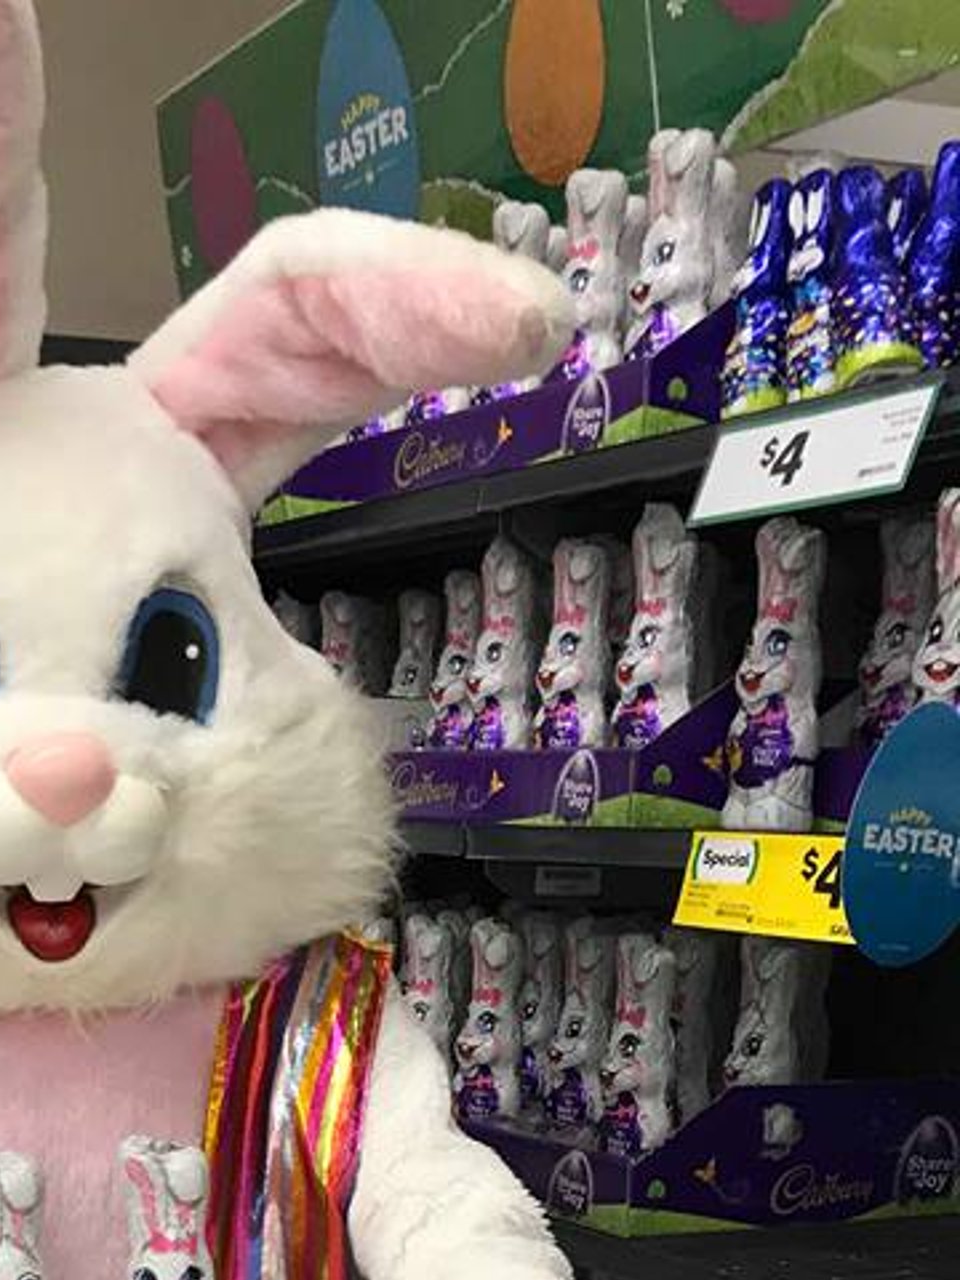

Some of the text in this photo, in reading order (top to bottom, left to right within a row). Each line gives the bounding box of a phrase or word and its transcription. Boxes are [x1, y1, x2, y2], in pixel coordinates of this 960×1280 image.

[341, 93, 380, 130] HAPPY
[323, 106, 409, 178] EASTER
[394, 432, 467, 489] Cadbury
[760, 430, 810, 486] $4
[889, 807, 932, 825] HAPPY
[863, 823, 952, 858] EASTER
[703, 849, 750, 870] Special
[802, 847, 843, 910] $4
[907, 1155, 955, 1174] Share
[917, 1172, 948, 1193] Joy
[771, 1164, 874, 1214] Cadbury
